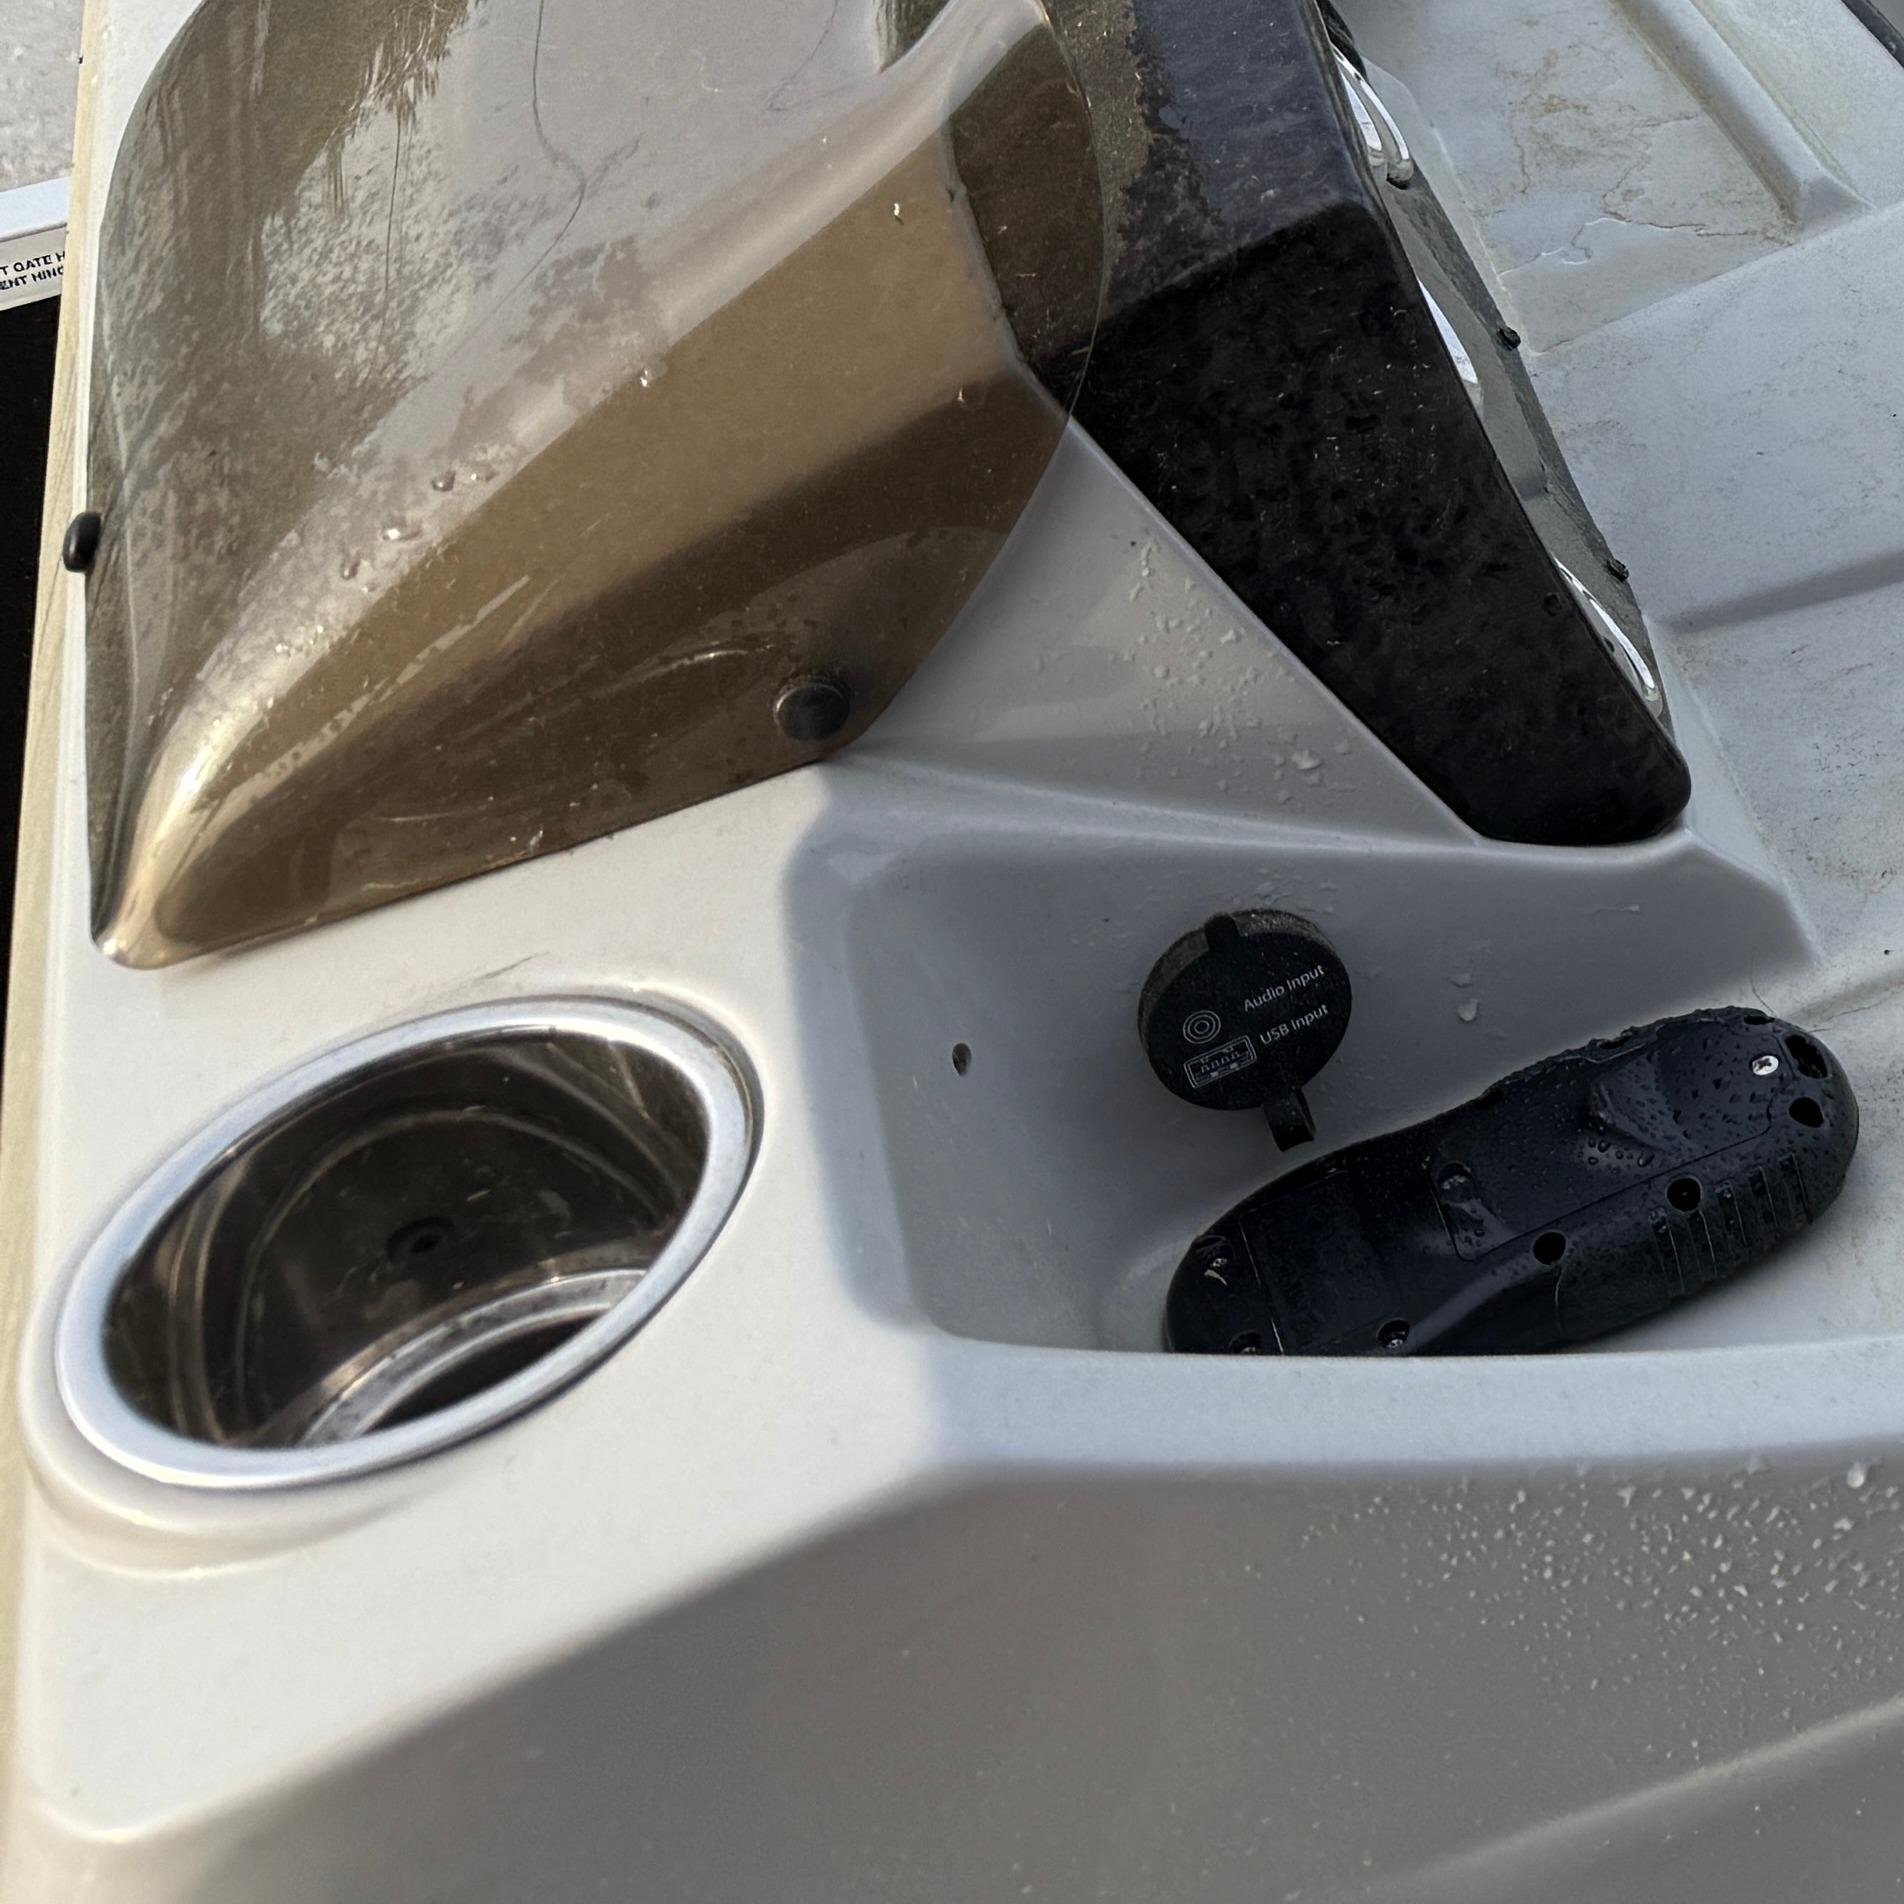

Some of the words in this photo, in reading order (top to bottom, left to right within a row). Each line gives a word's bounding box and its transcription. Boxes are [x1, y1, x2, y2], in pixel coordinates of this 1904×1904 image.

[1244, 985, 1285, 1013] Audio
[1286, 964, 1325, 992] Input
[1260, 1023, 1290, 1045] USB
[1291, 1004, 1329, 1032] Input
